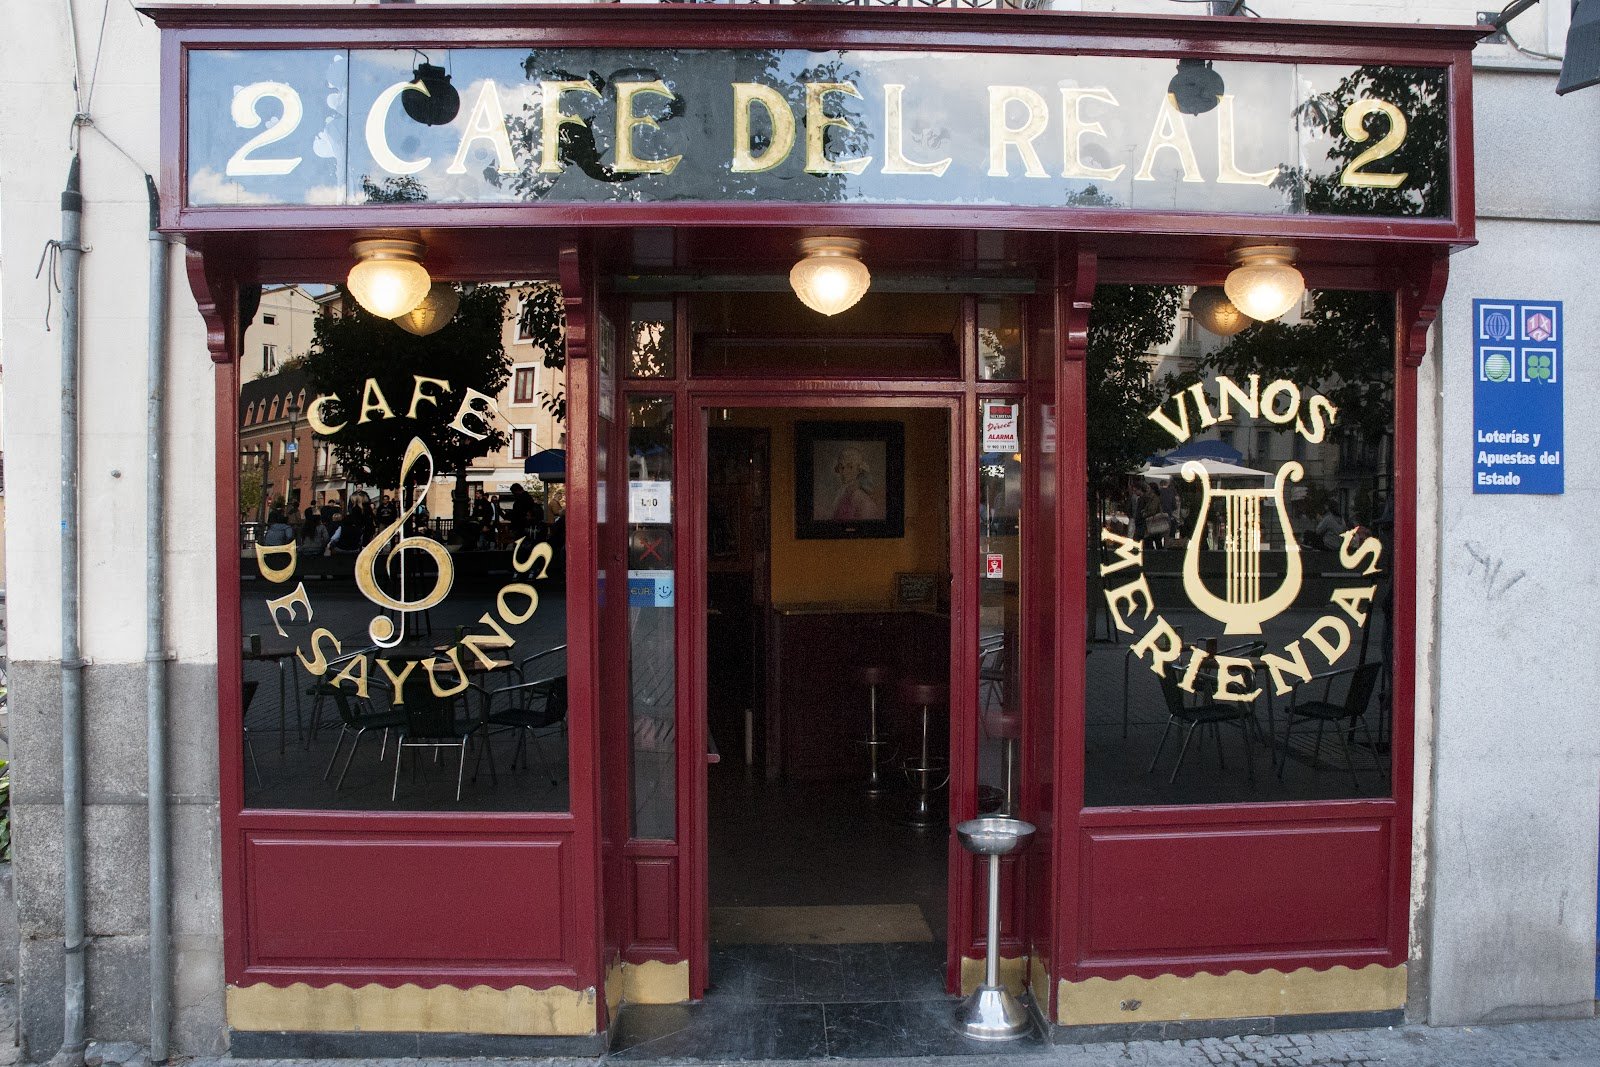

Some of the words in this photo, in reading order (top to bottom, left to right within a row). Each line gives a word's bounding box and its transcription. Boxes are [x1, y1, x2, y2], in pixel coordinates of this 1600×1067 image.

[225, 82, 303, 177] 2
[364, 79, 683, 176] CAFE
[730, 82, 952, 178] DEL
[986, 84, 1280, 188] REAL
[1340, 97, 1409, 190] 2
[306, 374, 500, 441] CAFE
[1147, 372, 1338, 445] VINOS
[1477, 429, 1530, 444] Loterías
[1532, 432, 1541, 447] y
[1477, 451, 1536, 467] Apuestas
[1539, 451, 1560, 465] del
[1477, 471, 1521, 486] Estado
[254, 536, 554, 705] DESAYUNOS
[1099, 525, 1384, 703] MERIENDAS
